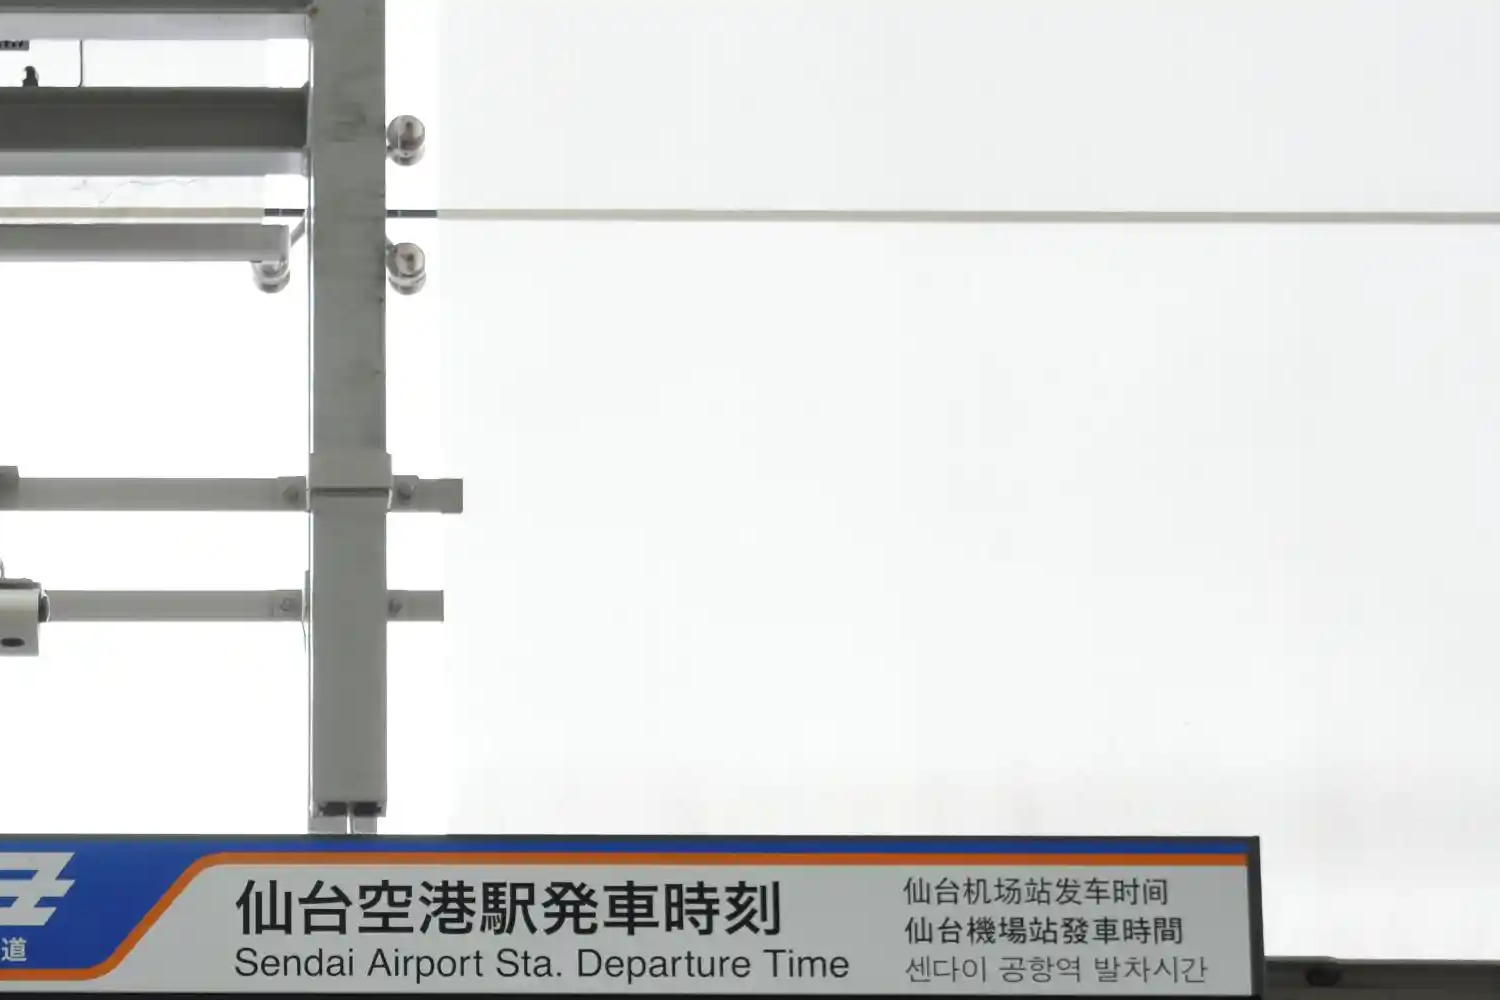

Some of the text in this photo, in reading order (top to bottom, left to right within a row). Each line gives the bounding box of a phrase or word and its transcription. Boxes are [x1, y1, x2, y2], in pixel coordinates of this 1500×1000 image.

[903, 877, 1167, 905] 仙台机场站发车时间
[236, 880, 780, 936] 仙台空港駅発車時刻
[905, 917, 1182, 944] 仙台機場站發車時間
[236, 948, 849, 984] Sendai Airport Sta. Departure Time
[906, 956, 1208, 983] 센다이 공항역 발차시간
